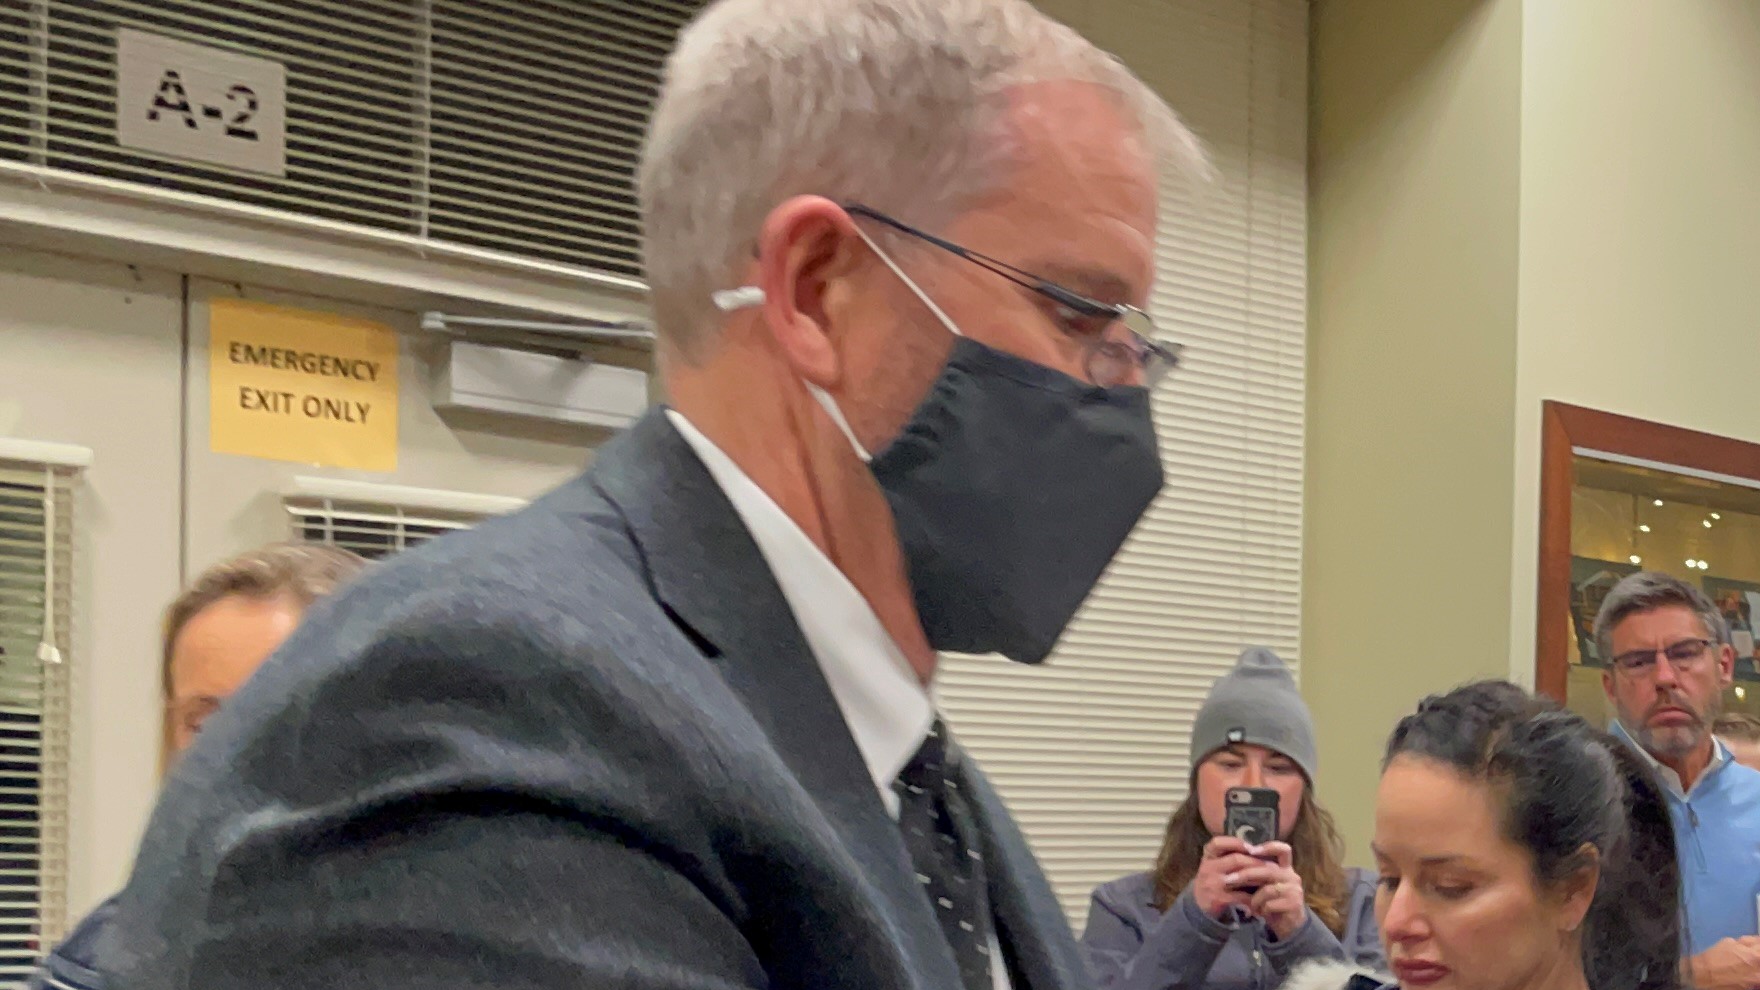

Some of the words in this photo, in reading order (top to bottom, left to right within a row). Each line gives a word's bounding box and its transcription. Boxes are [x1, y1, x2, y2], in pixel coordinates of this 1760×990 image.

[145, 69, 259, 142] A-2
[229, 341, 380, 384] EMERGENCY
[240, 386, 295, 415] EXIT
[302, 396, 371, 426] ONLY
